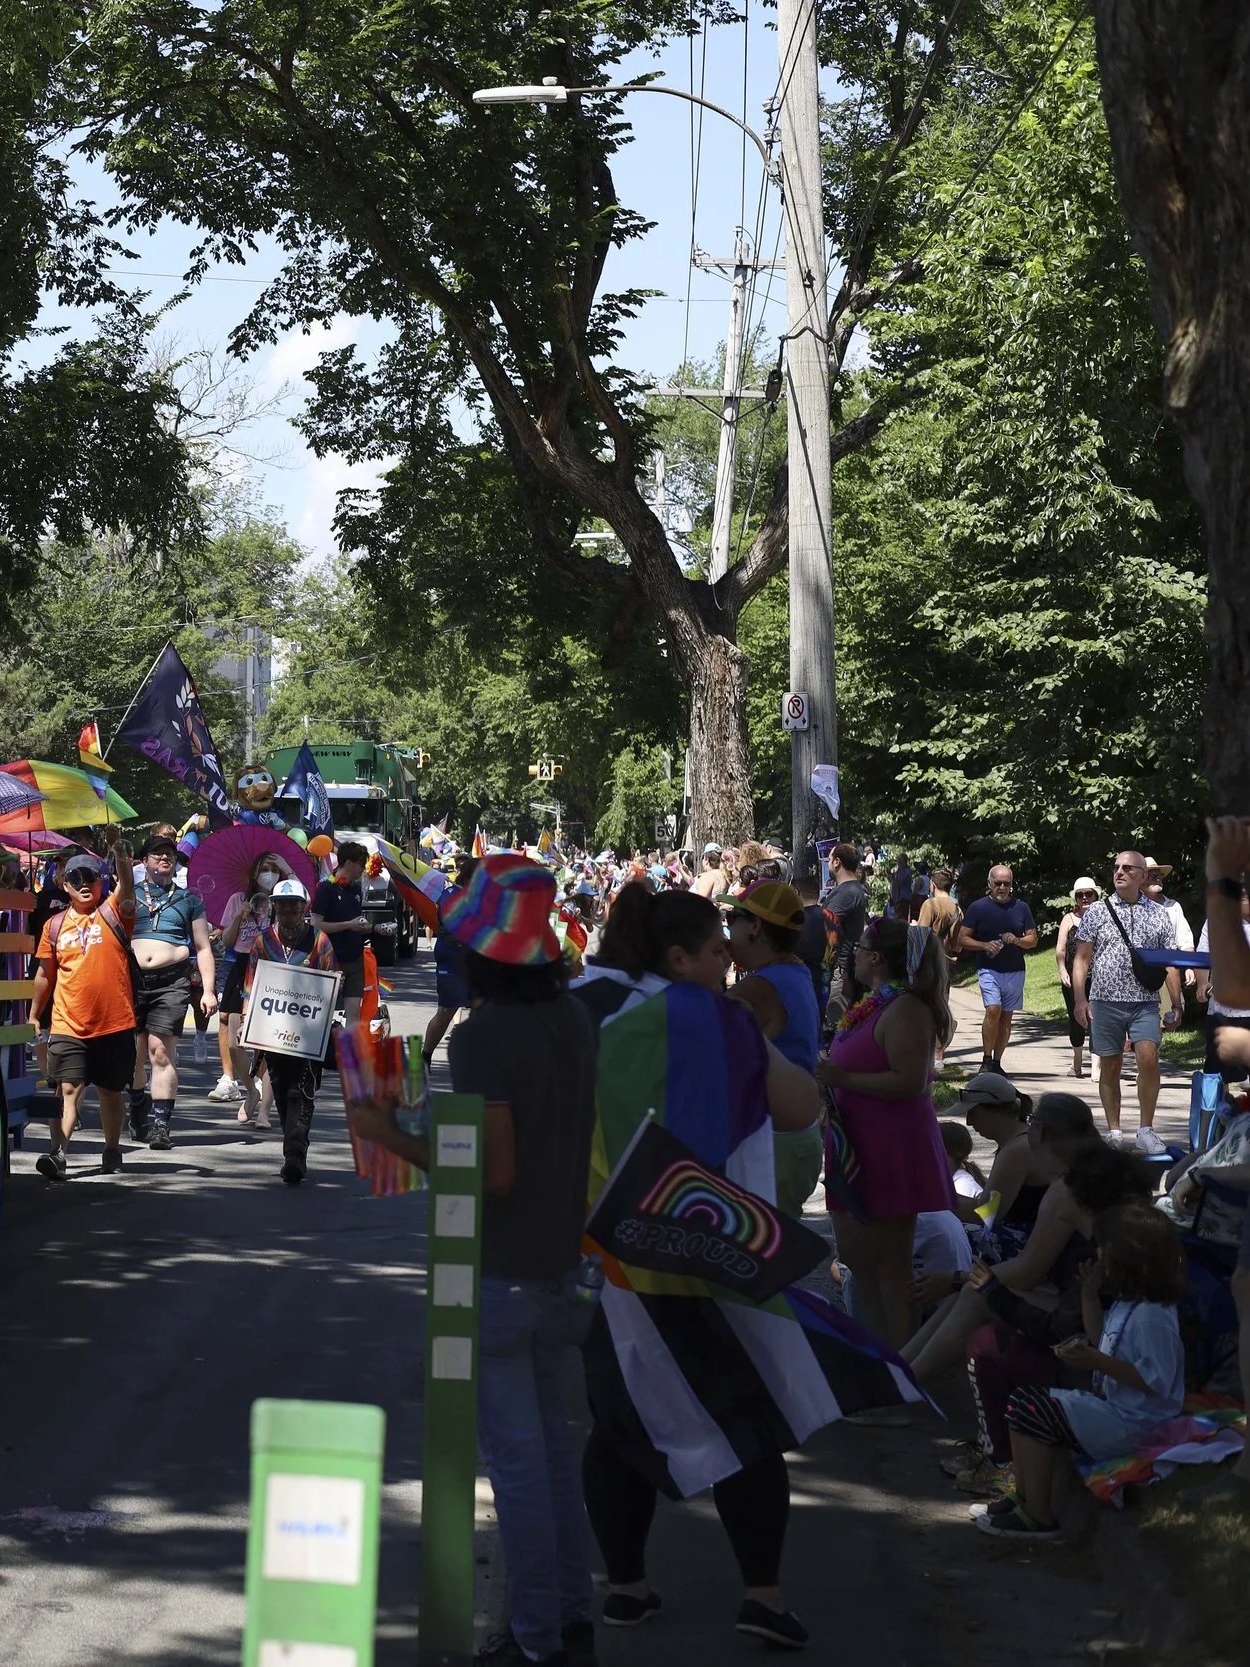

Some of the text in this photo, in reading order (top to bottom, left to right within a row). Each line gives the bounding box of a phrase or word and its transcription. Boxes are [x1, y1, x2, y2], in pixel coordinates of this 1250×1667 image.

[59, 924, 101, 950] Pre
[265, 985, 325, 1003] Unapologetically
[260, 997, 321, 1020] queer
[614, 1218, 758, 1279] #PROUD
